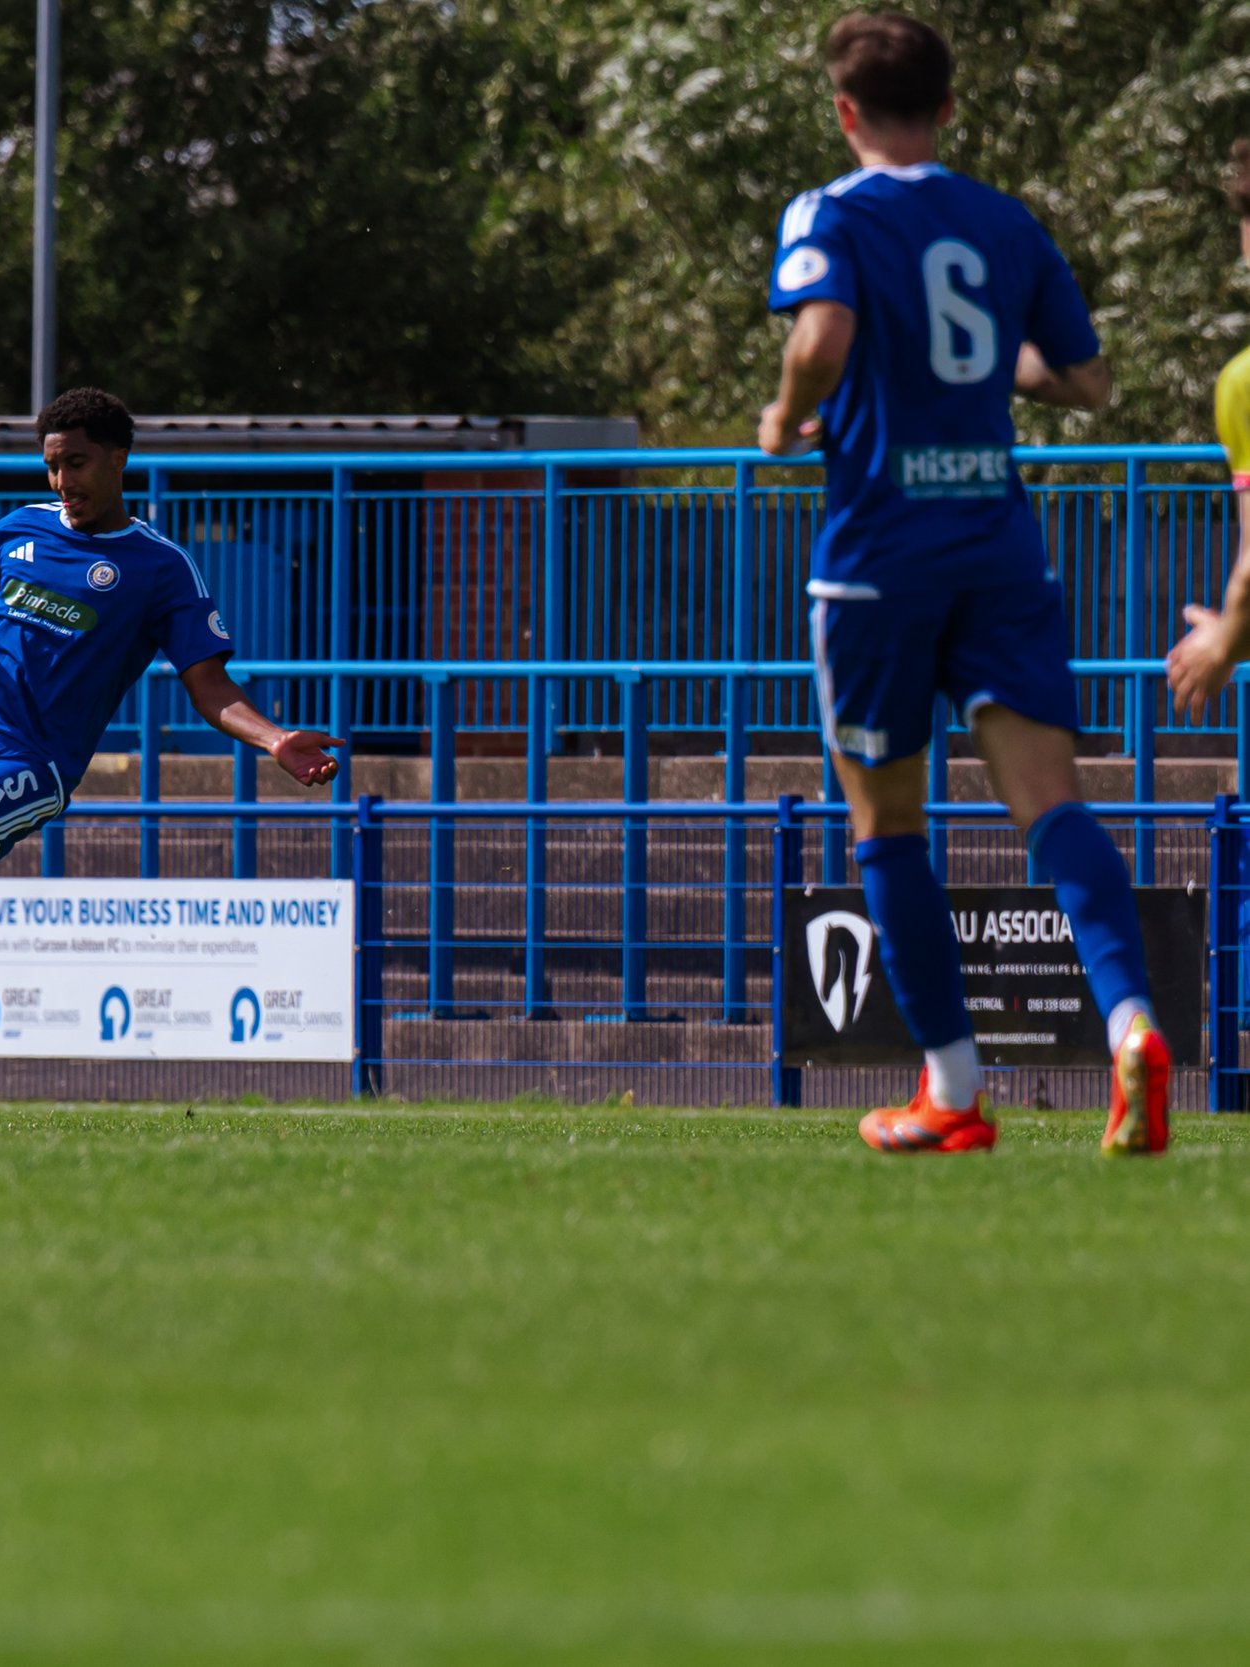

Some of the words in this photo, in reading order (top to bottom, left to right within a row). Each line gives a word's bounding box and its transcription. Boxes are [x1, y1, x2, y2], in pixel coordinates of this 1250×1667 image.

[922, 238, 998, 385] 6
[13, 586, 82, 623] Pinnacle
[21, 898, 73, 926] YOUR
[78, 898, 172, 926] BUSINESS
[176, 899, 220, 926] TIME
[224, 899, 266, 926] AND
[270, 899, 341, 927] MONEY
[70, 937, 105, 953] Ashton
[107, 937, 120, 953] FC
[2, 988, 42, 1007] GREAT
[134, 989, 173, 1008] GREAT
[263, 990, 303, 1009] GREAT
